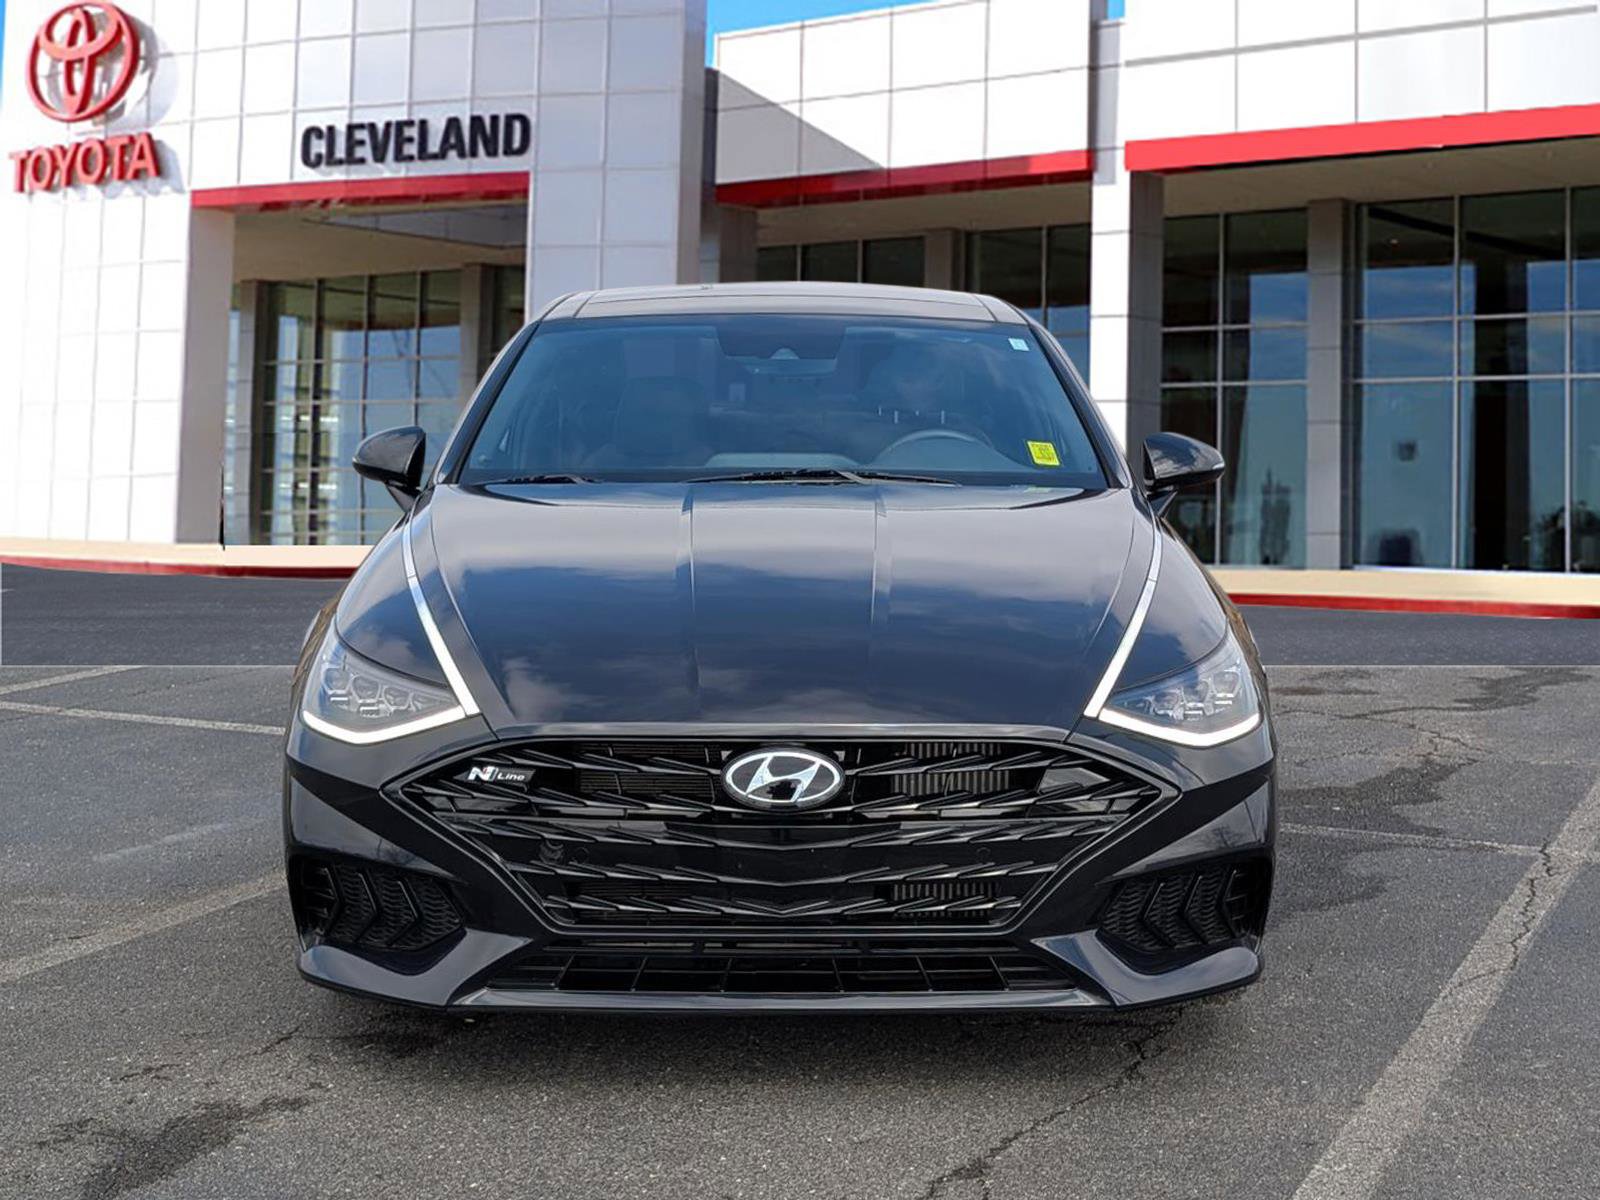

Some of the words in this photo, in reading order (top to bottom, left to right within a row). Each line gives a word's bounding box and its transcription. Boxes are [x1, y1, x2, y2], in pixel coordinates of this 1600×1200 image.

[9, 132, 161, 193] TOYOTA
[301, 113, 531, 169] CLEVELAND
[497, 772, 525, 781] Line
